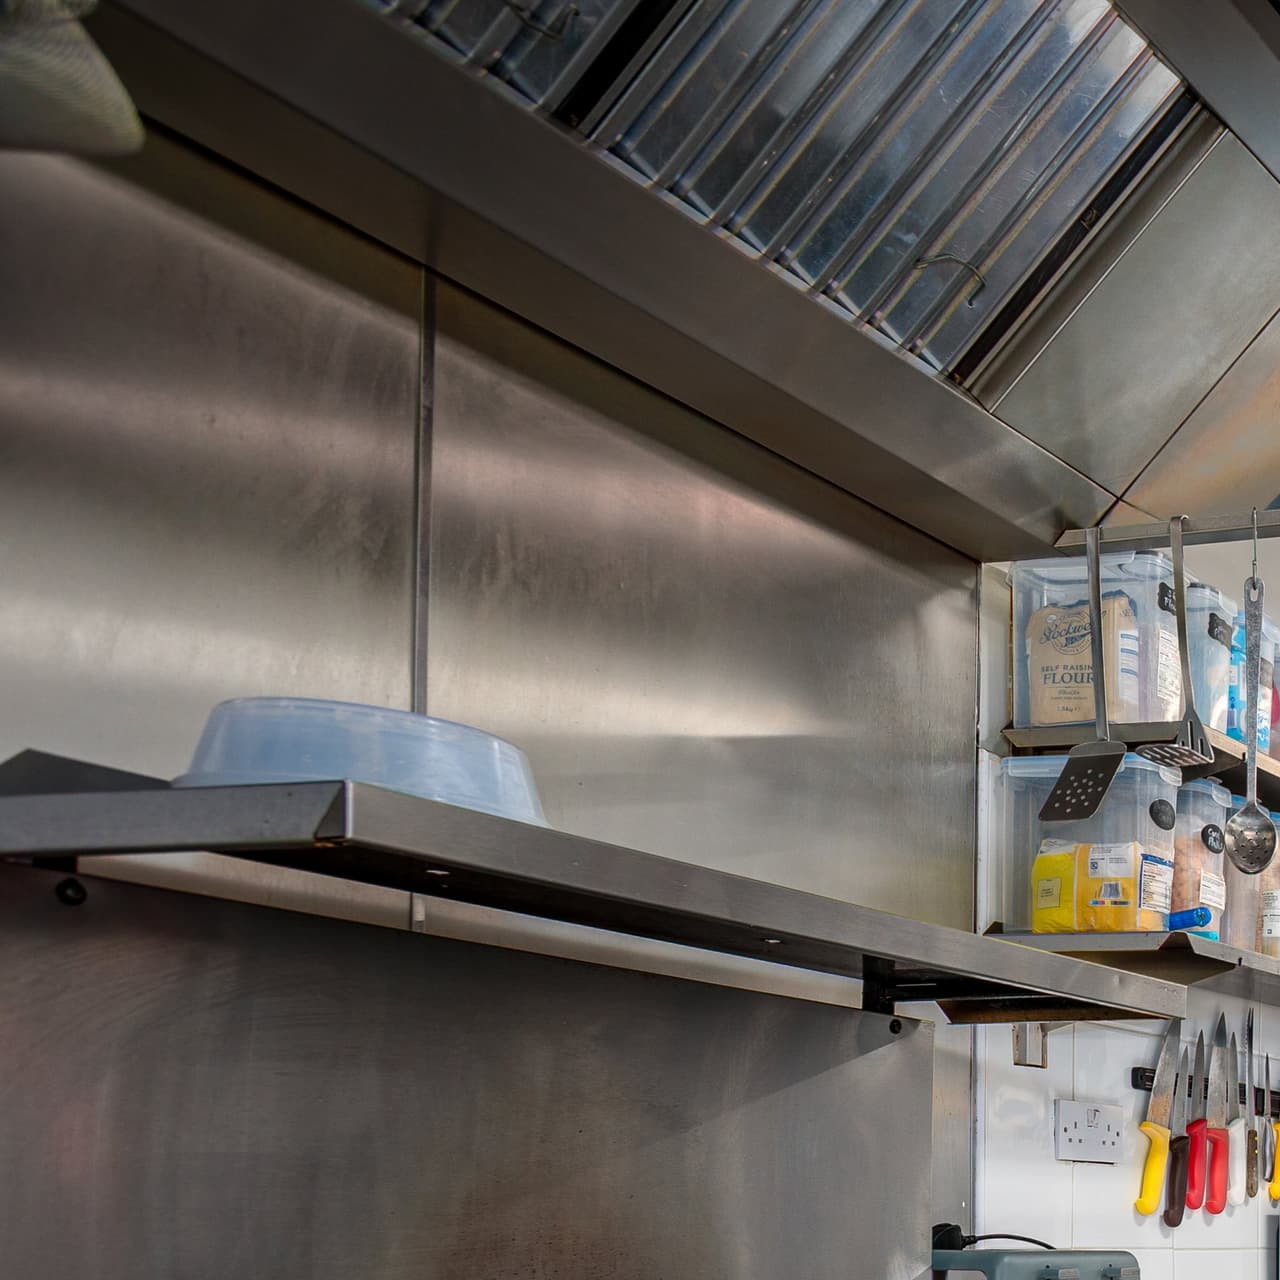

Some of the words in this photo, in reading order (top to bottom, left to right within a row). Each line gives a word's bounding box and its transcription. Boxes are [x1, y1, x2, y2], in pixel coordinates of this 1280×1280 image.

[1041, 617, 1093, 645] Stockwe
[1063, 663, 1093, 671] RAISIN
[1043, 672, 1095, 685] FLOUR
